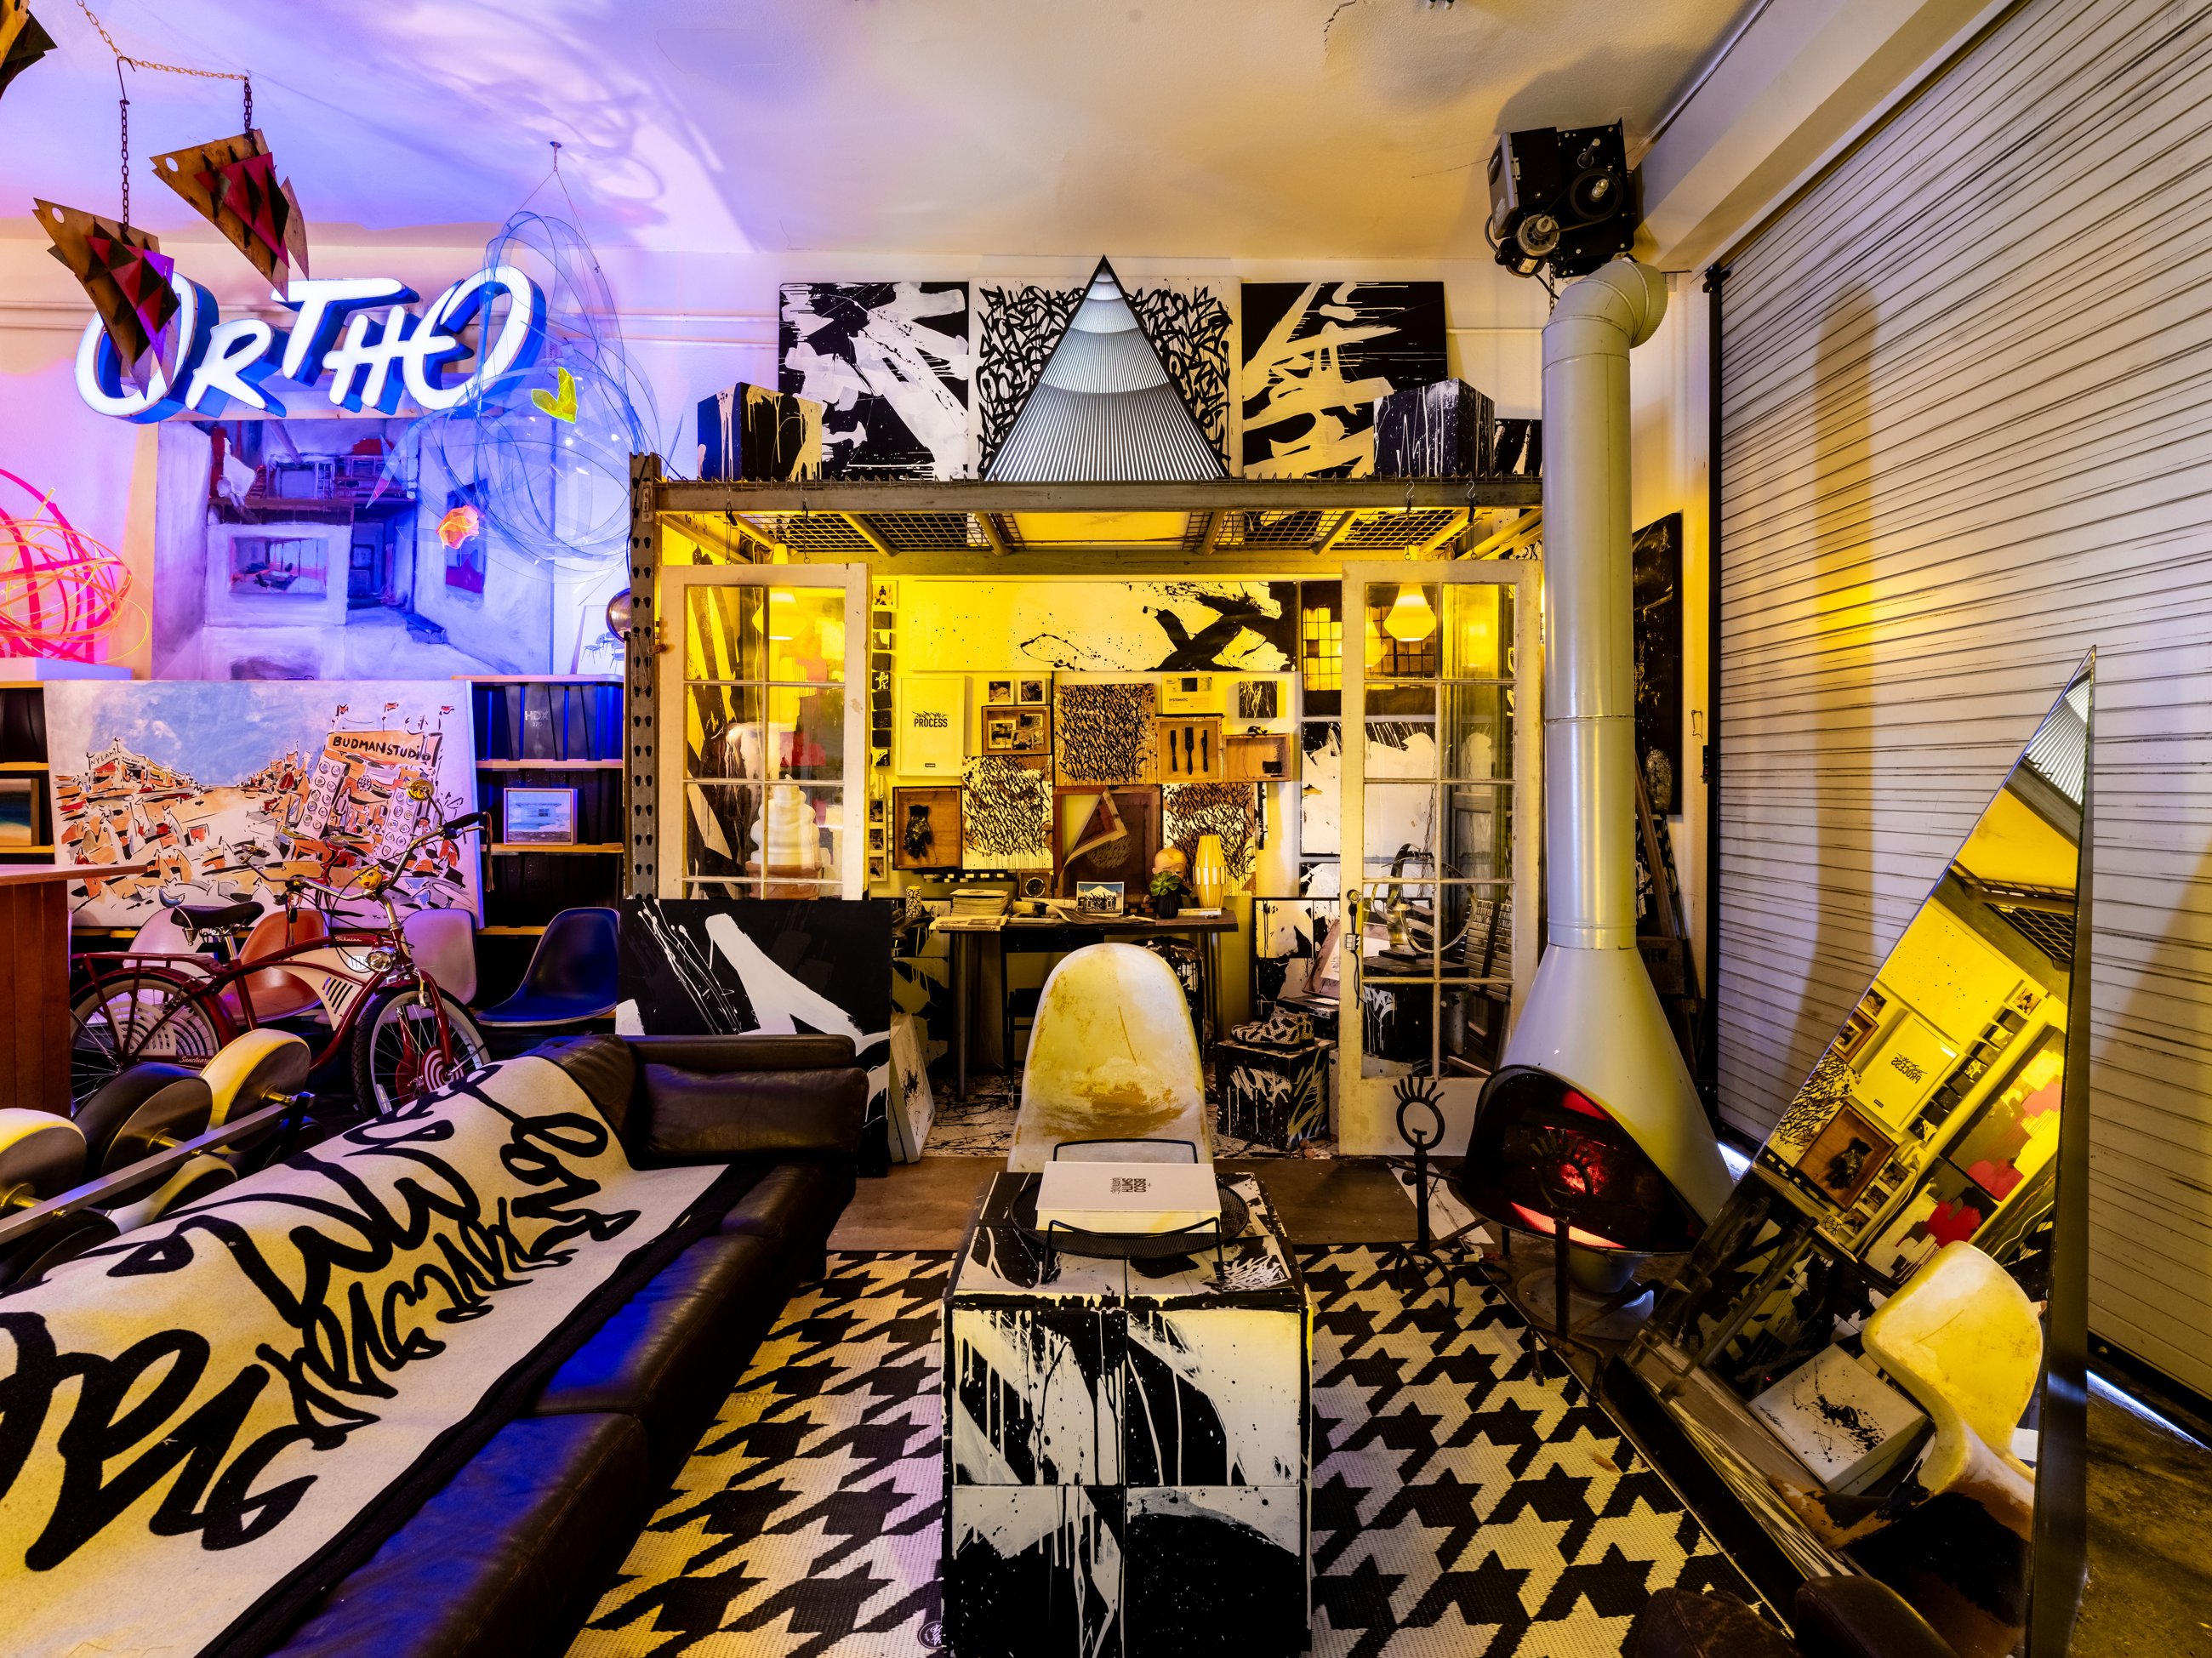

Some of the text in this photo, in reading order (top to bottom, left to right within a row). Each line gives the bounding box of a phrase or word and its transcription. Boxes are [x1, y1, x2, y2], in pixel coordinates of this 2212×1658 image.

[525, 710, 549, 721] HDX
[914, 718, 948, 727] PROCESS
[1122, 1177, 1133, 1192] SMITH
[1134, 1178, 1146, 1192] BISCO
